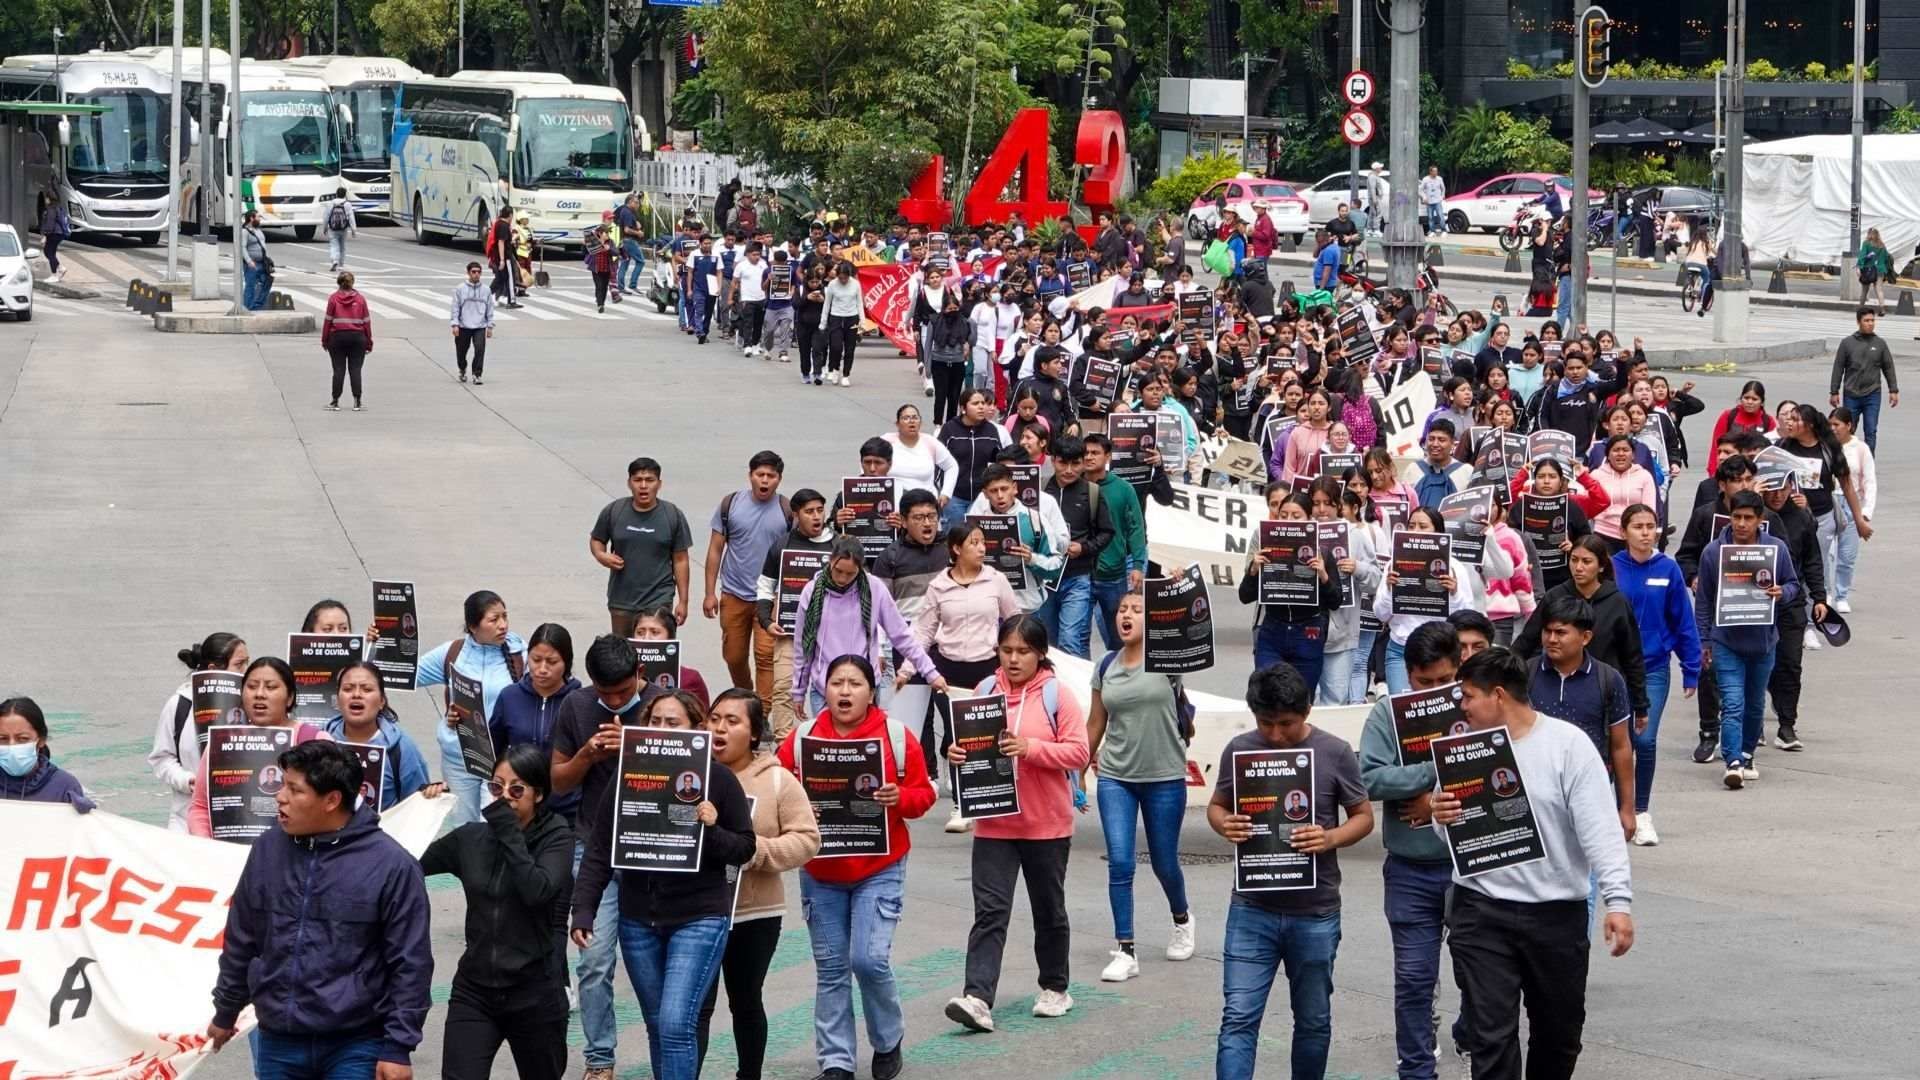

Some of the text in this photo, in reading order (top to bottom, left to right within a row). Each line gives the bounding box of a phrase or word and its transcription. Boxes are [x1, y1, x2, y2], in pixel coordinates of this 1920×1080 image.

[556, 200, 582, 208] Costa
[1178, 581, 1196, 594] OLVIDA
[1426, 696, 1445, 706] MAYO
[986, 710, 1002, 718] OLVIDA
[1405, 702, 1455, 718] NO SE OLVIDA
[636, 746, 648, 754] NO
[662, 747, 692, 756] OLVIDA
[1466, 742, 1484, 751] MAYO
[1445, 748, 1496, 764] NO SE OLVIDA
[1266, 768, 1297, 776] OLVIDA
[49, 957, 97, 1028] A
